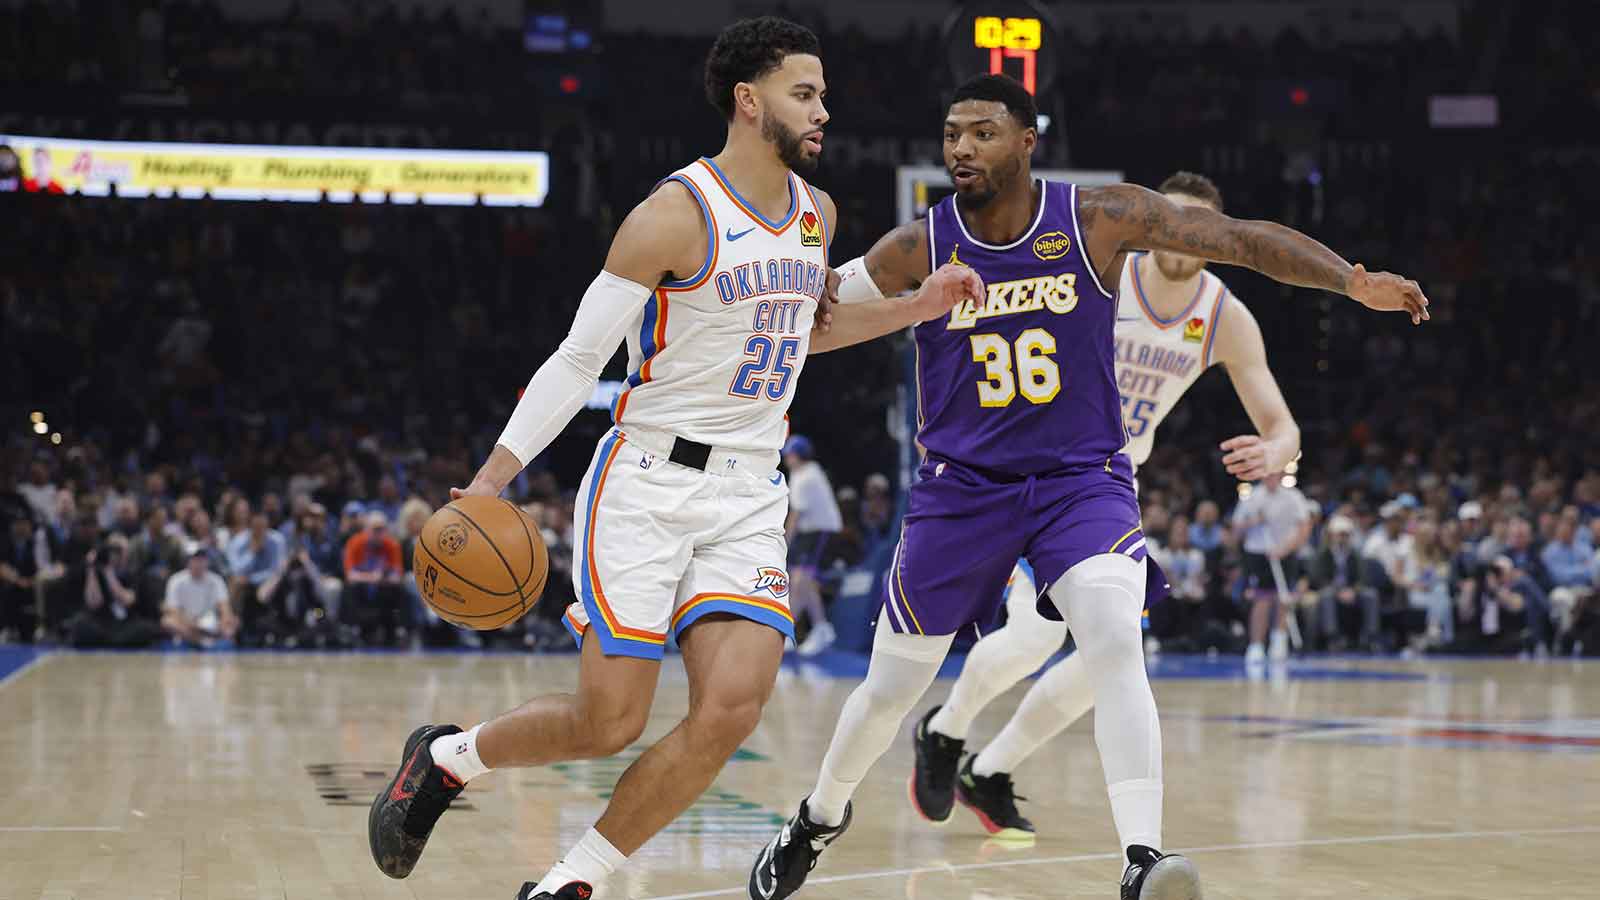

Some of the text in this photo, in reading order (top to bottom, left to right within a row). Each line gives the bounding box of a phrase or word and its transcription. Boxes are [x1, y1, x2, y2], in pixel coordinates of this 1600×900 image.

[142, 155, 233, 185] Heating
[263, 159, 371, 186] Plumbing
[1036, 239, 1068, 251] bibigo
[714, 258, 826, 305] OKLAHOMA
[753, 300, 804, 334] CITY
[728, 333, 801, 401] 25
[969, 328, 1062, 408] 36
[1118, 367, 1166, 397] CITY
